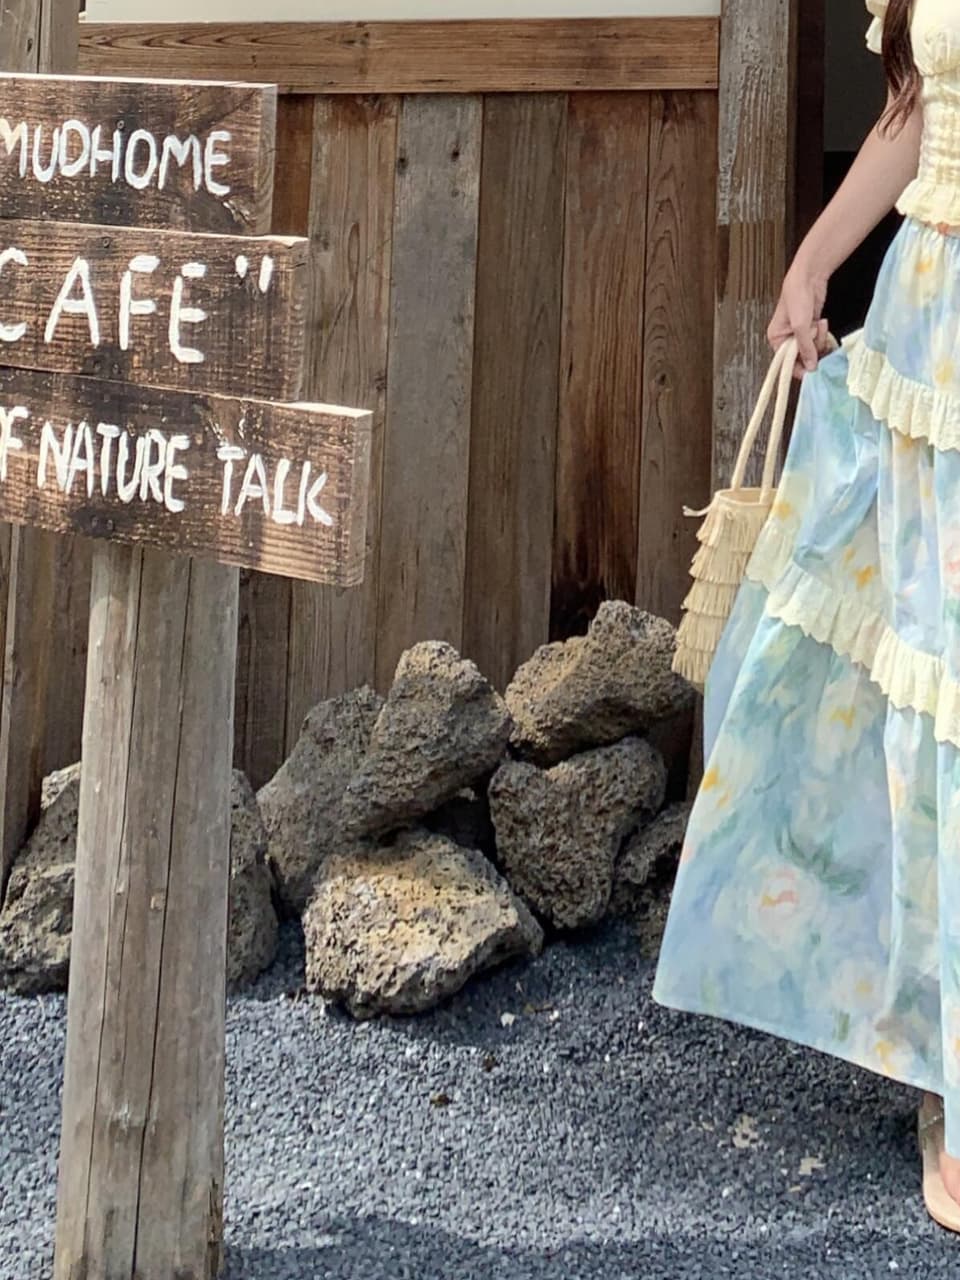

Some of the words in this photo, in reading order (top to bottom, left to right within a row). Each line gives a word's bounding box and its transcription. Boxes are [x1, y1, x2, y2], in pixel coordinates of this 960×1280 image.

[0, 118, 232, 195] MUDHOME
[0, 406, 29, 481] F
[37, 420, 190, 513] NATURE
[217, 444, 334, 527] TALK
